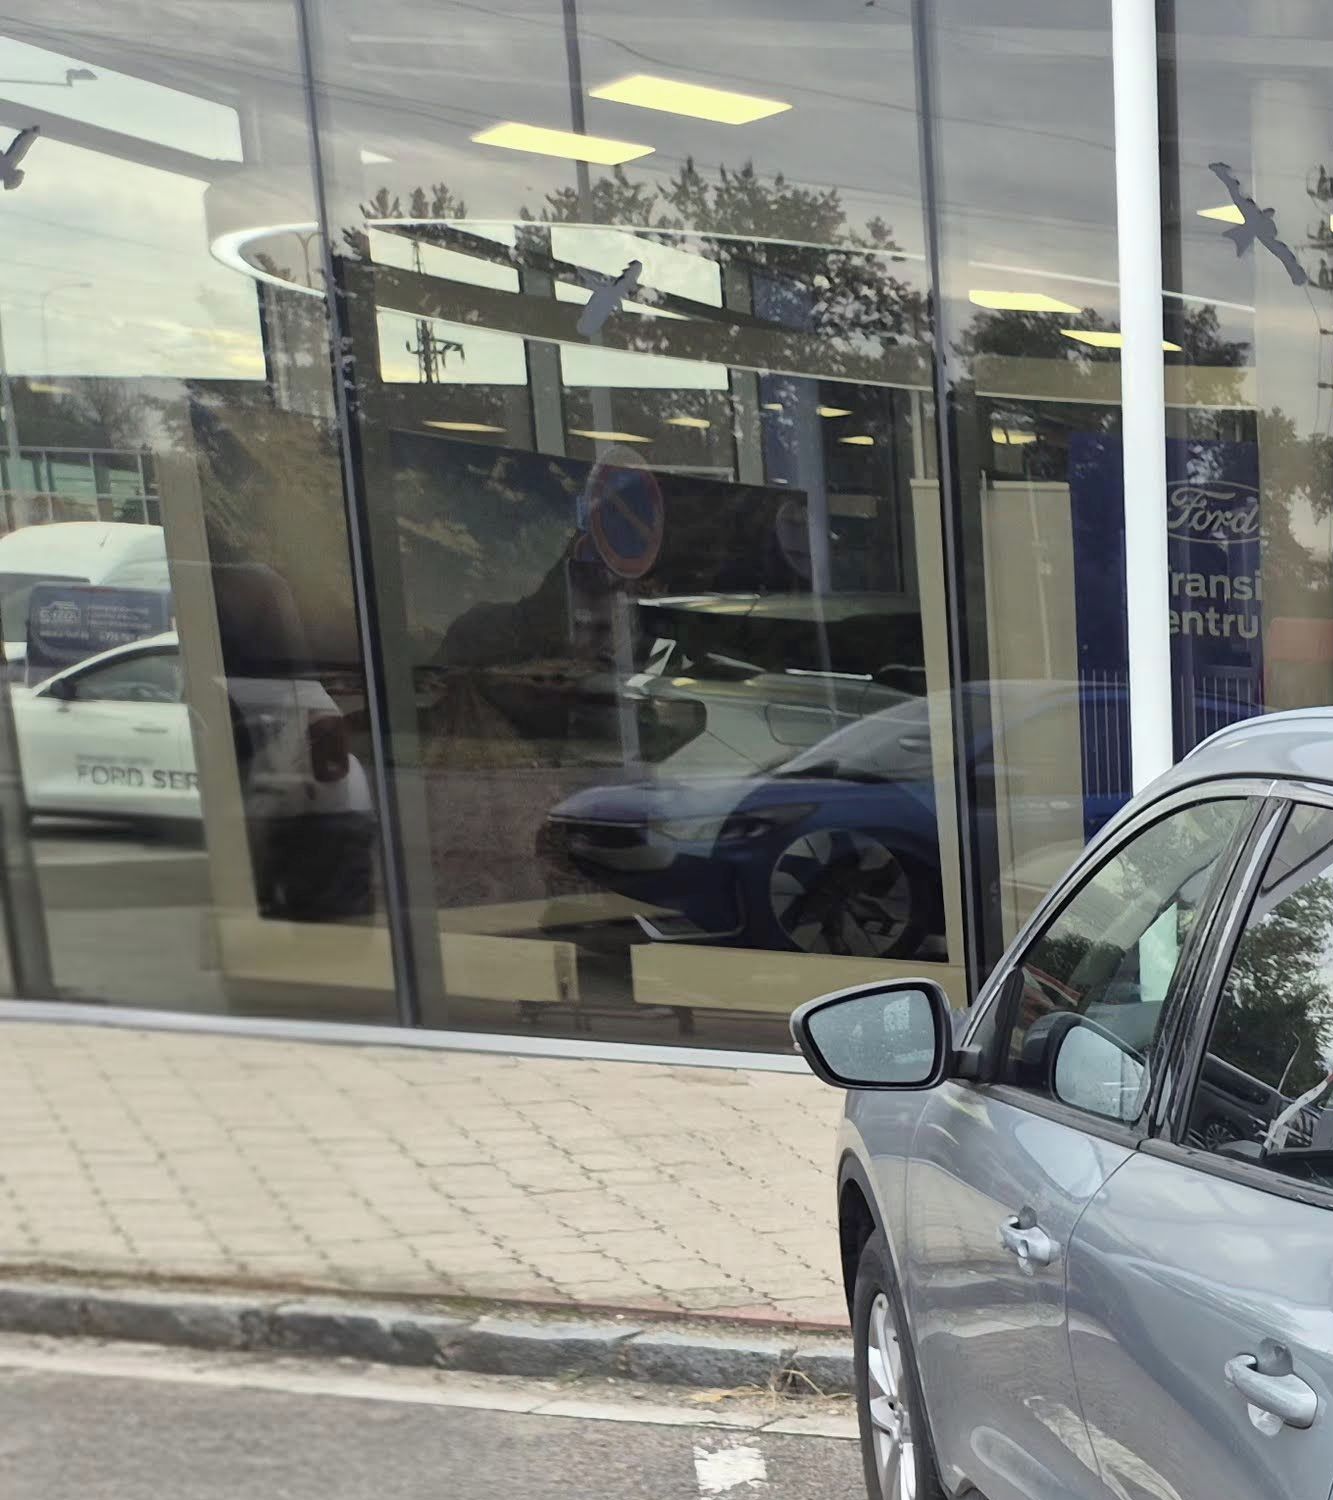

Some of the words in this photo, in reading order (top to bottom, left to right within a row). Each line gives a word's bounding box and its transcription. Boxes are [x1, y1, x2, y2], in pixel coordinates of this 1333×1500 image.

[1167, 486, 1260, 535] Ford
[1168, 567, 1263, 601] ransi
[1169, 606, 1259, 639] entru
[77, 764, 144, 788] FORD
[151, 768, 200, 791] SER
